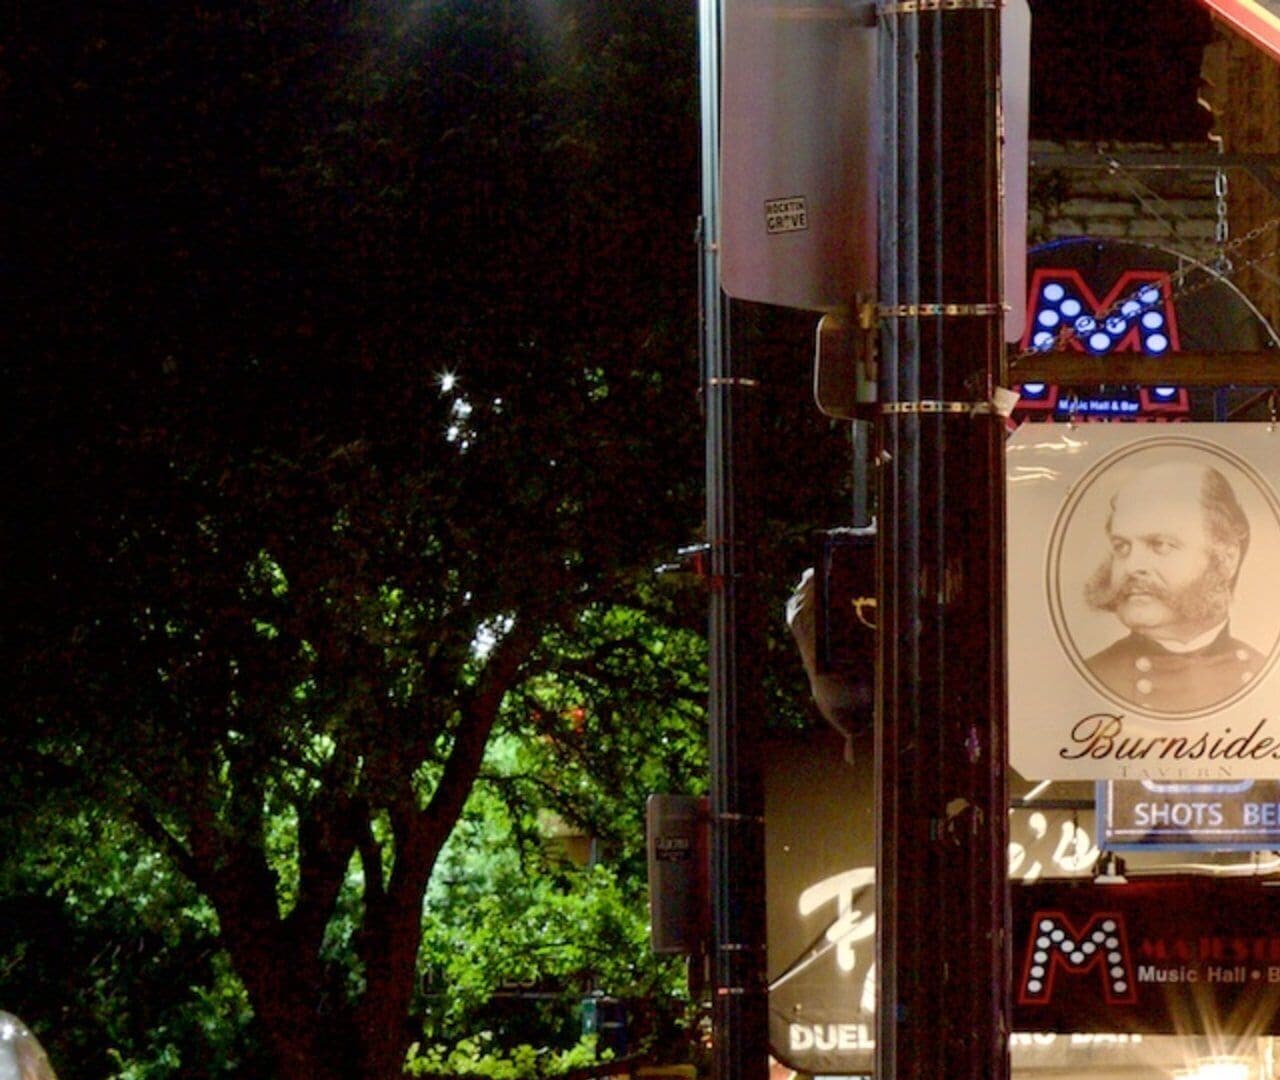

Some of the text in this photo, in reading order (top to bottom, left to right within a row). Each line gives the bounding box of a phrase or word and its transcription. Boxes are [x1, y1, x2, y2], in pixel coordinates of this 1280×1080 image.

[1134, 802, 1223, 827] SHOTS
[1137, 965, 1199, 983] Music
[1207, 965, 1246, 983] Hall
